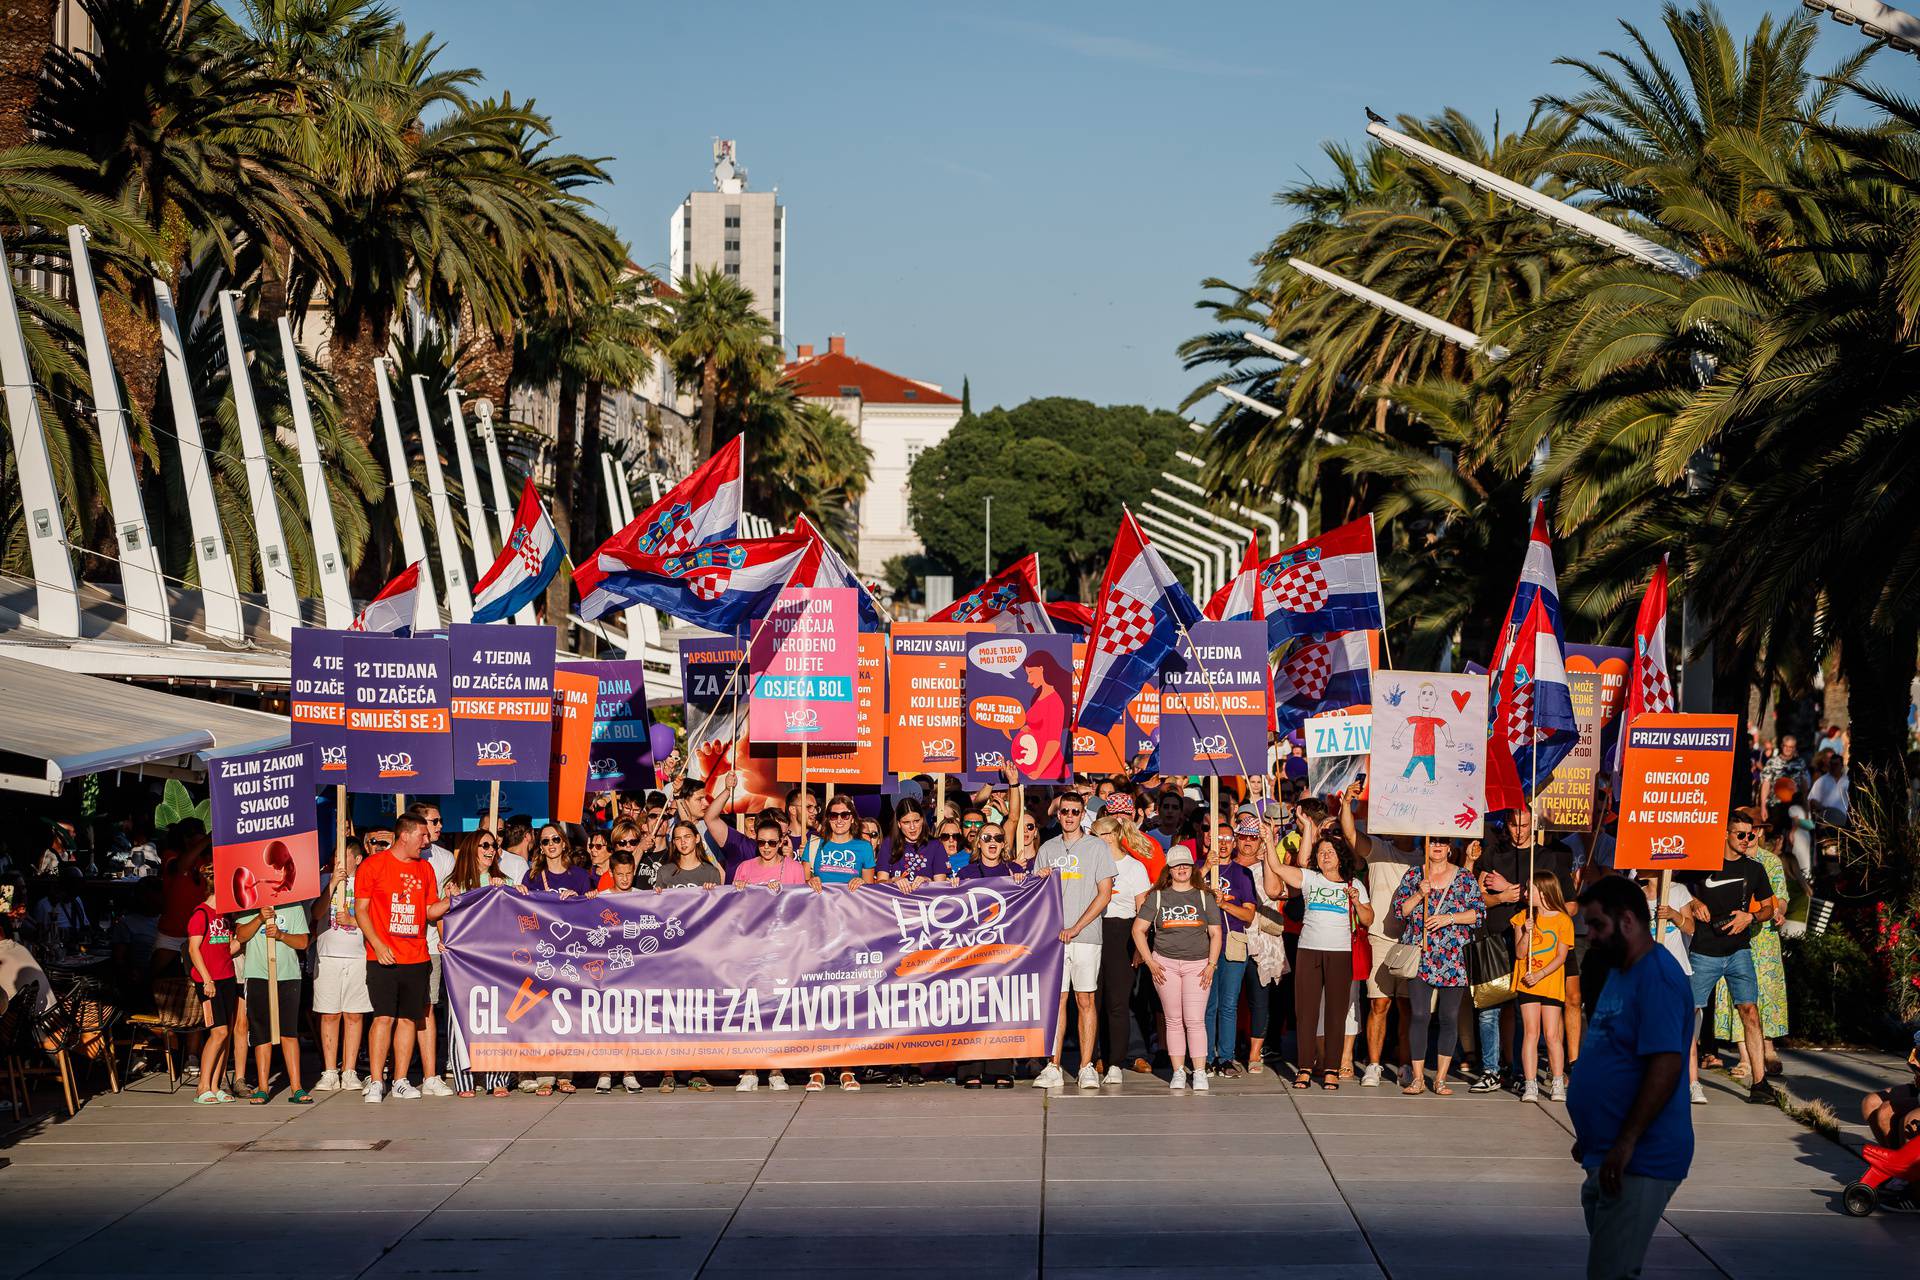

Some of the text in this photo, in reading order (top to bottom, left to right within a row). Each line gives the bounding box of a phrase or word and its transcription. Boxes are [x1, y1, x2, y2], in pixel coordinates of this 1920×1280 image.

[776, 599, 833, 614] PRILIKOM
[774, 616, 834, 633] POBAČAJA
[773, 638, 836, 653] NEROĐENO
[896, 639, 933, 652] PRIZIV
[979, 646, 1023, 656] MOJE TIJELO
[1183, 646, 1242, 660] 4 TJEDNA
[313, 655, 322, 669] 4
[472, 650, 532, 665] 4 TJEDNA
[785, 657, 824, 672] DIJETE
[979, 655, 1017, 665] MOJ IZBOR
[354, 662, 438, 679] 12 TJEDANA
[1164, 671, 1182, 685] OD
[1237, 671, 1262, 685] IMA
[296, 679, 312, 693] OD
[452, 672, 549, 691] OD ZAČEĆA IMA
[694, 675, 720, 696] ZA
[764, 677, 845, 697] OSJEĆA BOL
[1573, 679, 1594, 693] MOŽE
[357, 685, 437, 704] OD ZAČEĆA
[567, 690, 588, 705] IMA
[911, 696, 934, 708] KOJI
[1194, 693, 1219, 711] UŠI,
[1222, 695, 1260, 709] NOS...
[451, 700, 549, 716] OTISKE PRSTIJU
[860, 698, 871, 707] da
[976, 702, 1022, 715] MOJE TIJELO
[294, 704, 337, 720] OTISKE
[351, 710, 407, 729] SMIJEŠI
[410, 713, 430, 729] SE
[784, 709, 817, 722] HOD
[975, 712, 1015, 725] MOJ IZBOR
[899, 714, 907, 727] A
[909, 715, 925, 727] NE
[614, 724, 639, 739] BOL
[1584, 724, 1592, 733] JE
[922, 738, 955, 753] HOD
[1192, 735, 1227, 750] HOD
[1315, 727, 1340, 754] ZA
[1632, 731, 1730, 746] PRIZIV SAVIJESTI
[477, 740, 511, 756] HOD
[1574, 747, 1592, 757] RODI
[221, 752, 304, 778] ŽELIM ZAKON
[377, 752, 412, 766] HOD
[233, 774, 294, 796] KOJI ŠTITI
[1645, 772, 1710, 785] GINEKOLOG
[1567, 779, 1591, 795] ŽENE
[240, 795, 289, 815] SVAKOG
[1541, 797, 1590, 810] TRENUTKA
[1643, 789, 1708, 806] KOJI LIJEČI,
[1554, 806, 1590, 826] ZAČEĆA
[1628, 808, 1718, 824] A NE USMRĆUJE
[236, 813, 295, 835] ČOVJEKA!
[1650, 835, 1684, 850] HOD
[821, 849, 856, 862] HOD
[892, 887, 1007, 939] HOD
[1161, 904, 1197, 916] HOD
[898, 922, 1012, 953] ZA ŽIVOT
[801, 967, 883, 982] www.hodzazivot.hr
[581, 988, 716, 1036] ROĐENIH
[721, 987, 763, 1034] ZA
[771, 978, 861, 1033] ŽIVOT
[867, 972, 1041, 1030] NEROĐENIH
[519, 1048, 541, 1057] KNIN
[631, 1048, 663, 1056] RIJEKA
[670, 1047, 691, 1056] SINJ
[697, 1047, 725, 1056] SISAK
[784, 1045, 809, 1054] BROD
[816, 1044, 841, 1052] SPLIT
[901, 1039, 944, 1049] VINKOVCI
[951, 1036, 982, 1046] ZADAR
[989, 1034, 1026, 1045] ZAGREB
